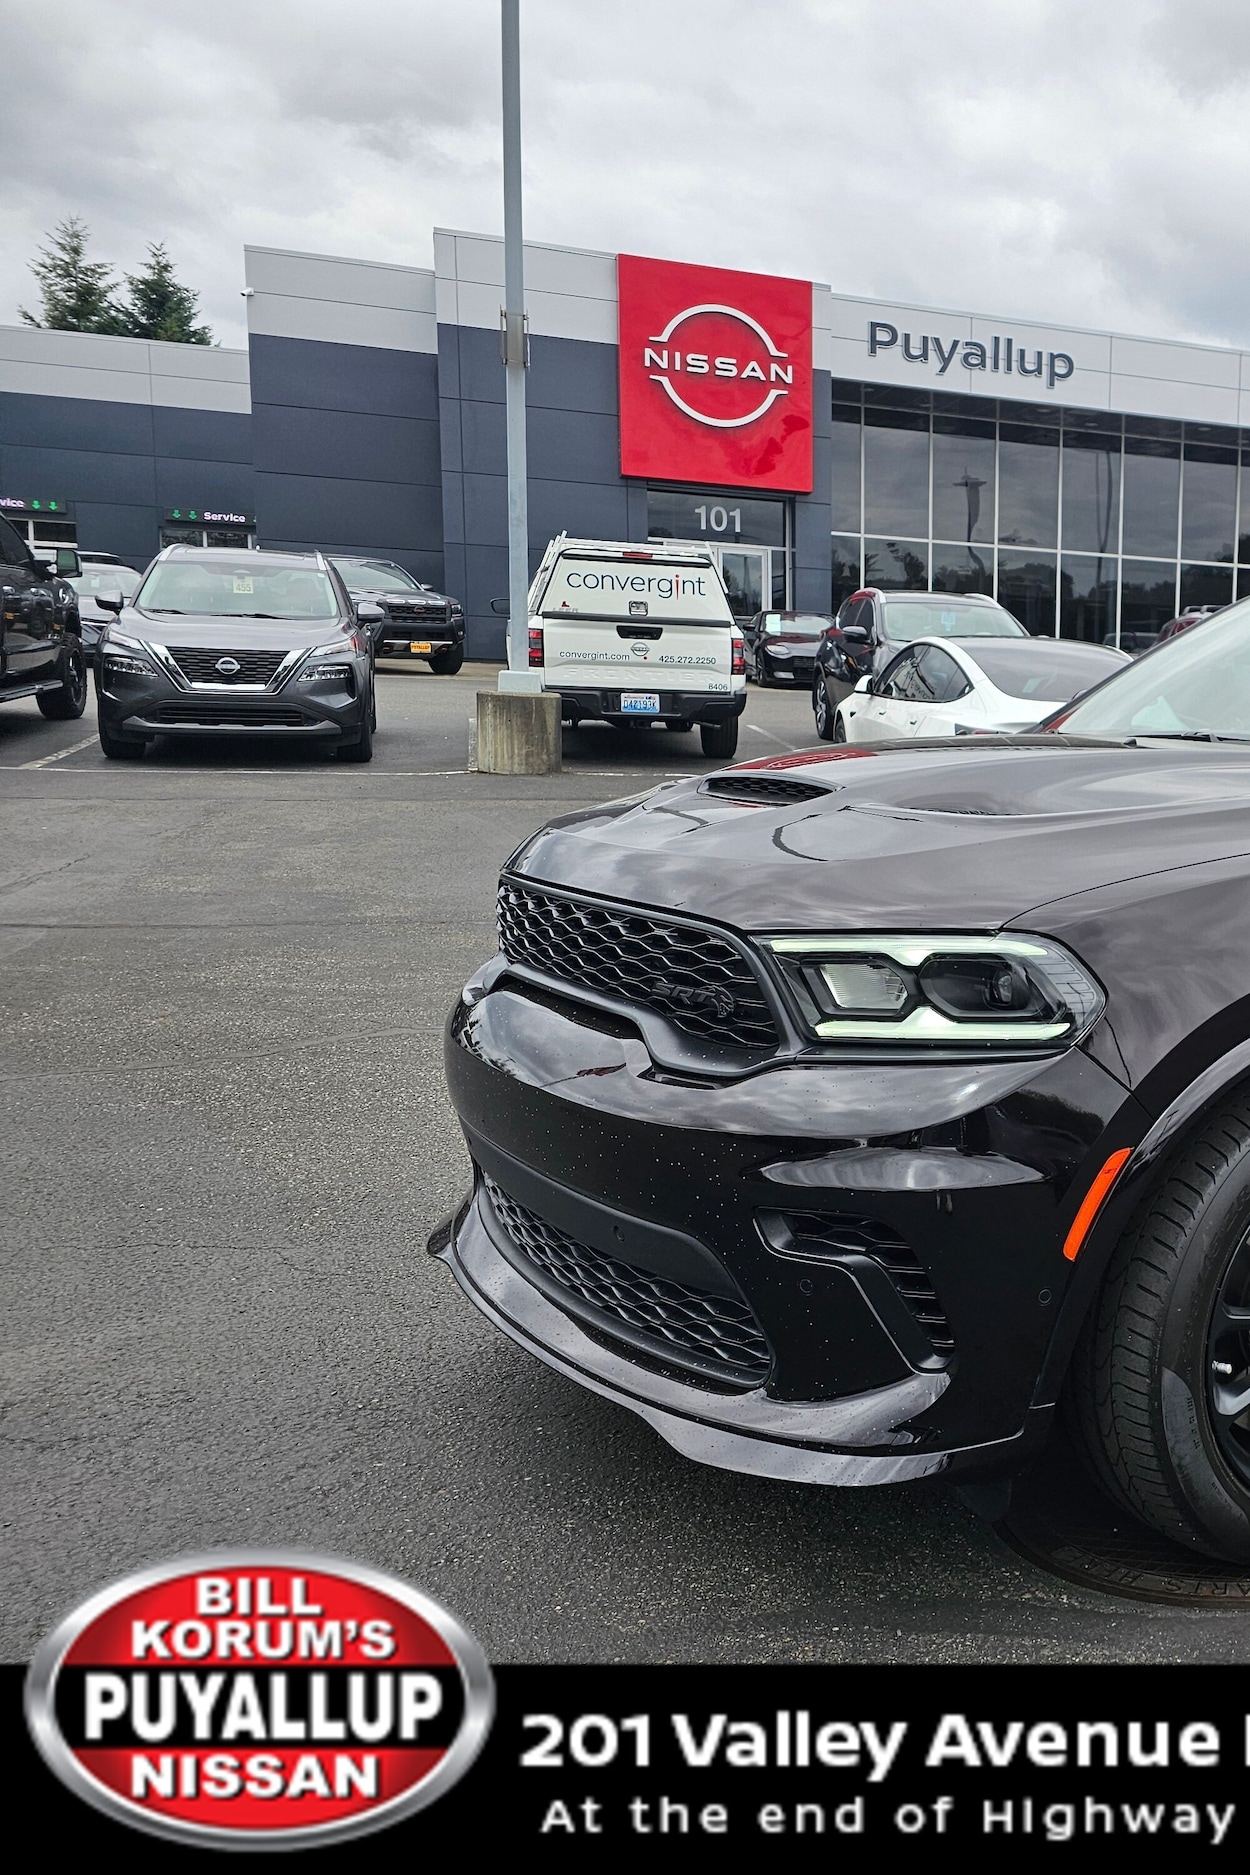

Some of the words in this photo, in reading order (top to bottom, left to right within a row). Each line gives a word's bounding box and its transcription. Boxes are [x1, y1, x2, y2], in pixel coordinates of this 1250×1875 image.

[644, 348, 793, 384] NISSAN
[867, 321, 1075, 389] Puyallup
[203, 511, 247, 523] Service
[694, 505, 741, 533] 101
[566, 572, 706, 600] convergint
[559, 651, 630, 661] convergint.com
[658, 655, 717, 665] 425.272.2250
[650, 981, 716, 1006] SRT
